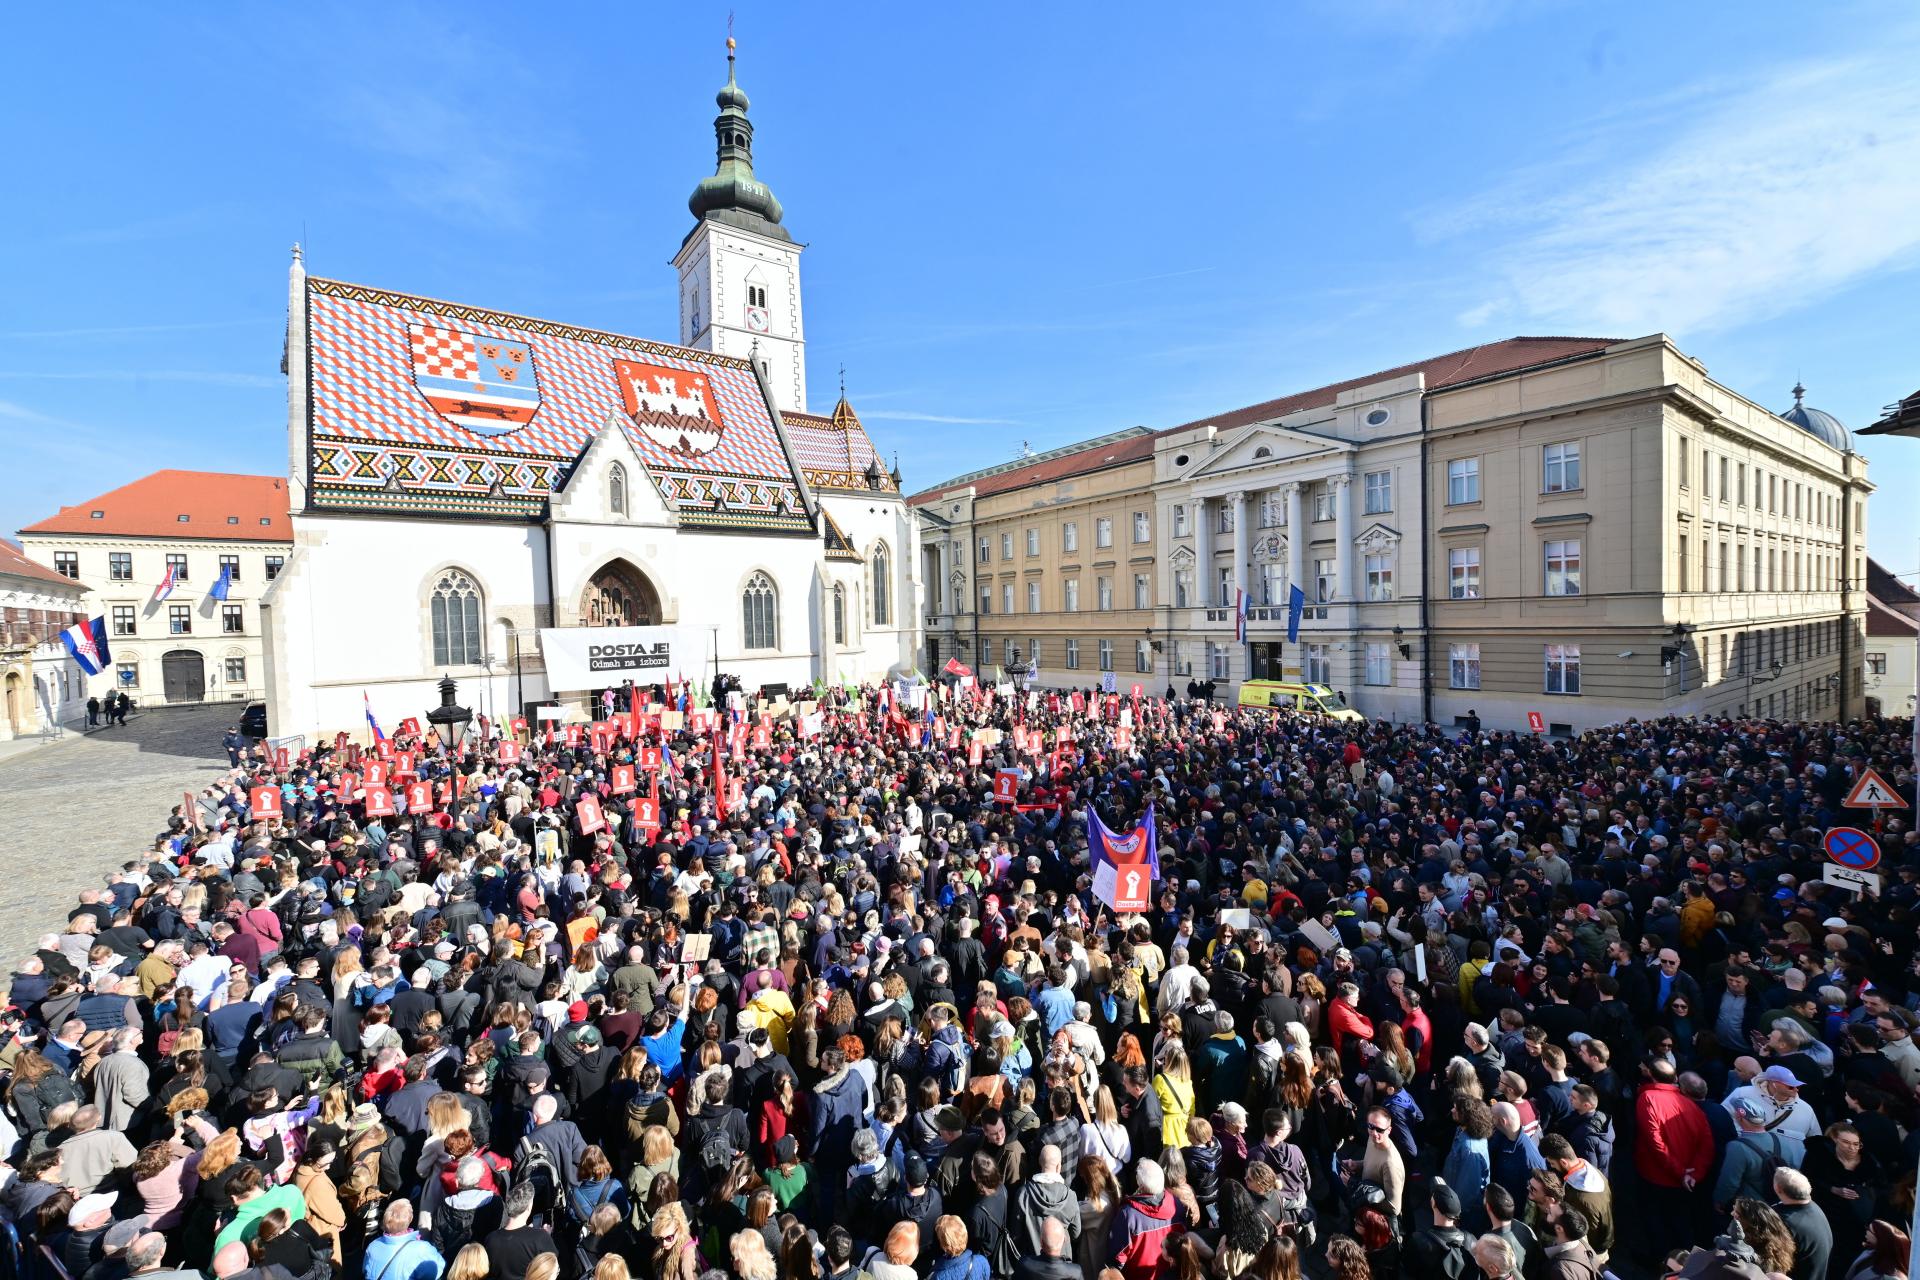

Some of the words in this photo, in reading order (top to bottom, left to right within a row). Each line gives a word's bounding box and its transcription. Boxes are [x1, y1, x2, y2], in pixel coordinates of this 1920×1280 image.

[589, 644, 647, 657] DOSTA
[650, 643, 669, 654] JE!
[592, 660, 620, 668] Odmah
